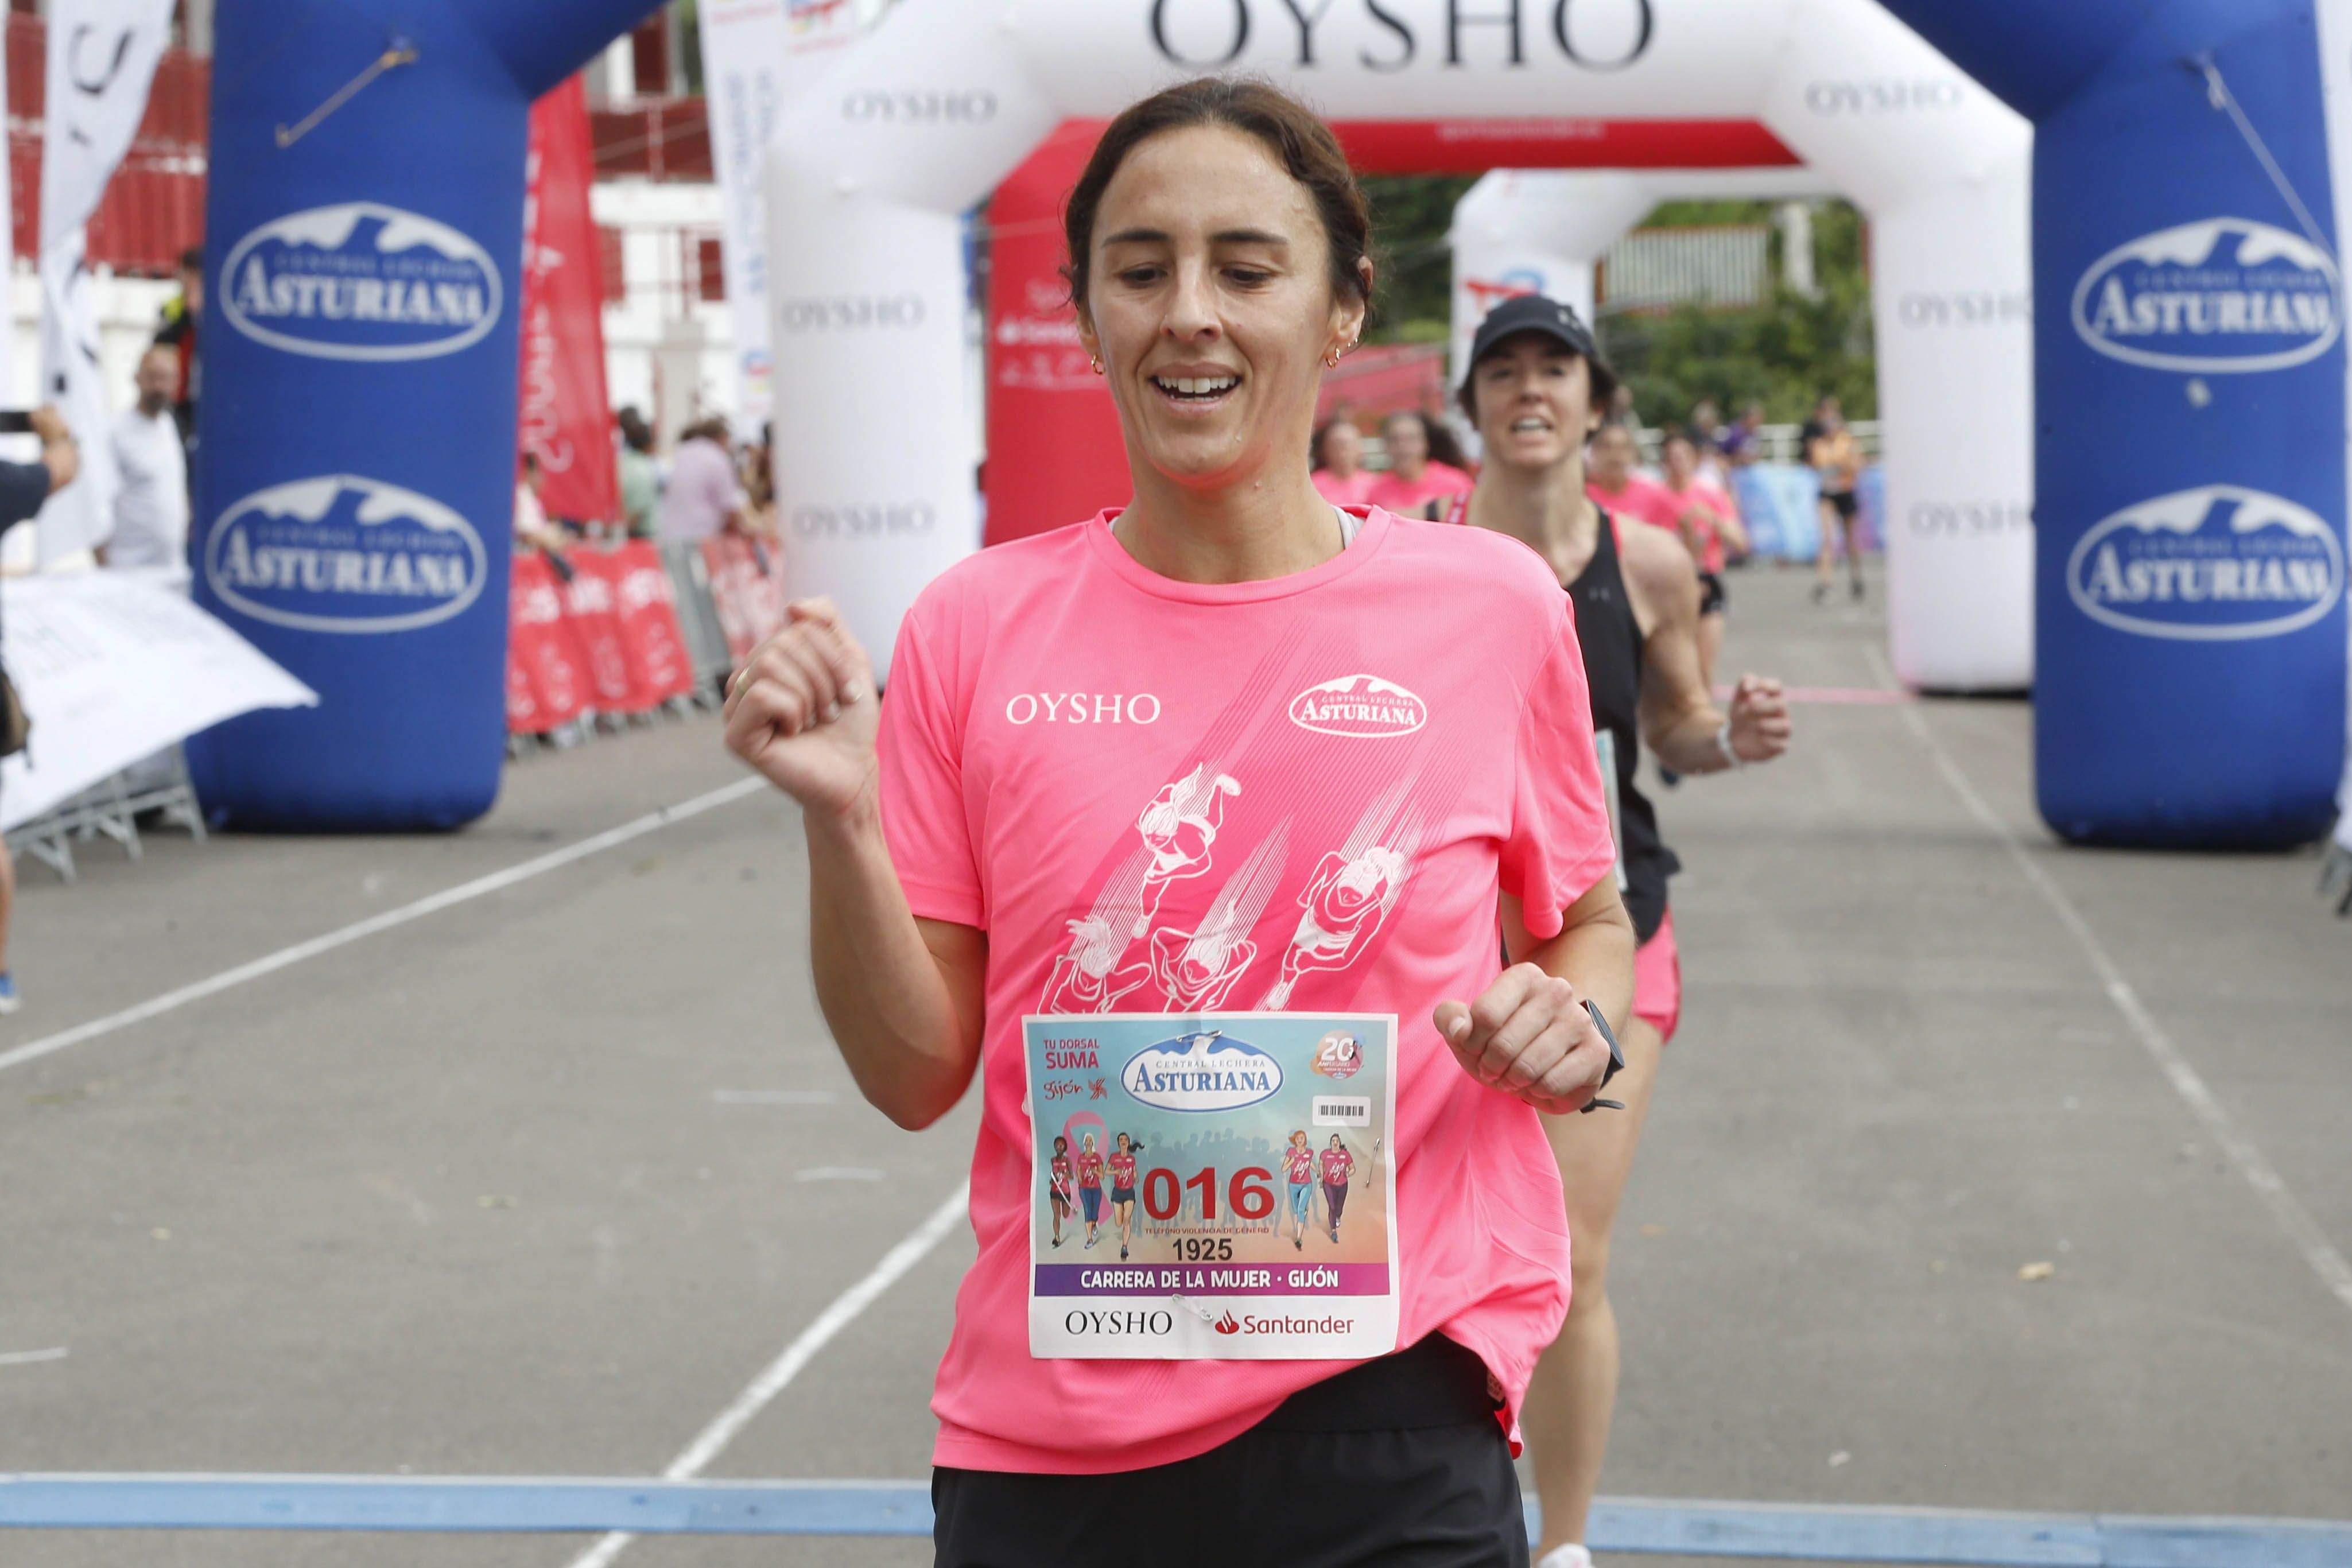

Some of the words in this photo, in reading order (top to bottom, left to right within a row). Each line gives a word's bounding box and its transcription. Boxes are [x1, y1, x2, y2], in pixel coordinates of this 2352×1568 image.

[1150, 0, 1655, 70] OYSHO
[841, 89, 998, 122] OYSHO
[233, 253, 482, 325] ASTURIANA
[220, 523, 467, 597] ASTURIANA
[1006, 692, 1161, 725] OYSHO
[1299, 697, 1417, 726] ASTURIANA
[1322, 695, 1367, 703] CENTRAL
[1370, 696, 1414, 707] LECHERA
[1043, 1039, 1056, 1050] TU
[1059, 1038, 1100, 1050] DORSAL
[1045, 1051, 1099, 1070] SUMA
[1155, 1060, 1206, 1069] CENTRAL
[1212, 1059, 1266, 1068] LECHERA
[1043, 1079, 1084, 1101] gijón
[1132, 1062, 1271, 1093] ASTURIANA
[1143, 1166, 1275, 1220] 016
[1173, 1238, 1233, 1261] 1925
[1080, 1270, 1156, 1288] CARRERA
[1161, 1270, 1181, 1288] DE
[1186, 1270, 1205, 1288] LA
[1210, 1270, 1271, 1288] MUJER
[1287, 1265, 1338, 1288] GIJÓN
[1065, 1310, 1173, 1336] OYSHO
[1243, 1315, 1354, 1334] Santander
